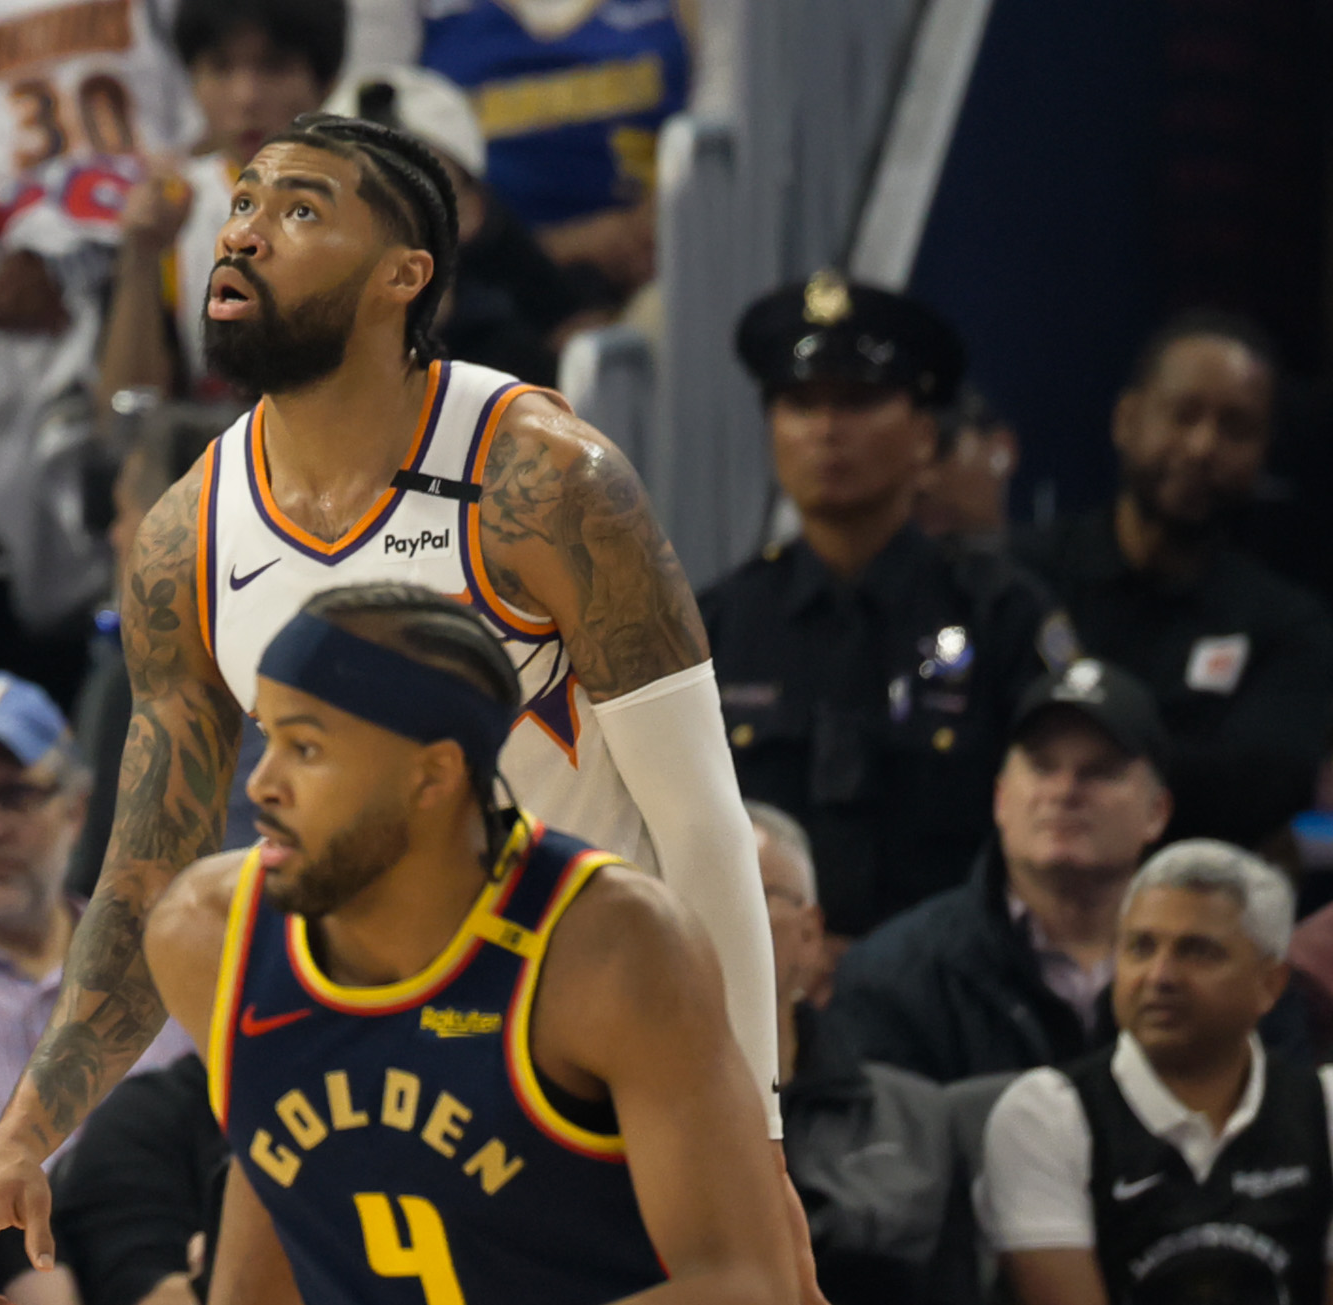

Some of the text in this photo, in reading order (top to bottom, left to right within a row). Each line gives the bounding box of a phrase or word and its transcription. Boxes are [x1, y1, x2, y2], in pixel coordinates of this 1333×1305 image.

[427, 478, 442, 495] AL
[384, 528, 450, 558] PayPal
[249, 1067, 528, 1196] GOLDEN
[353, 1191, 467, 1305] 4
